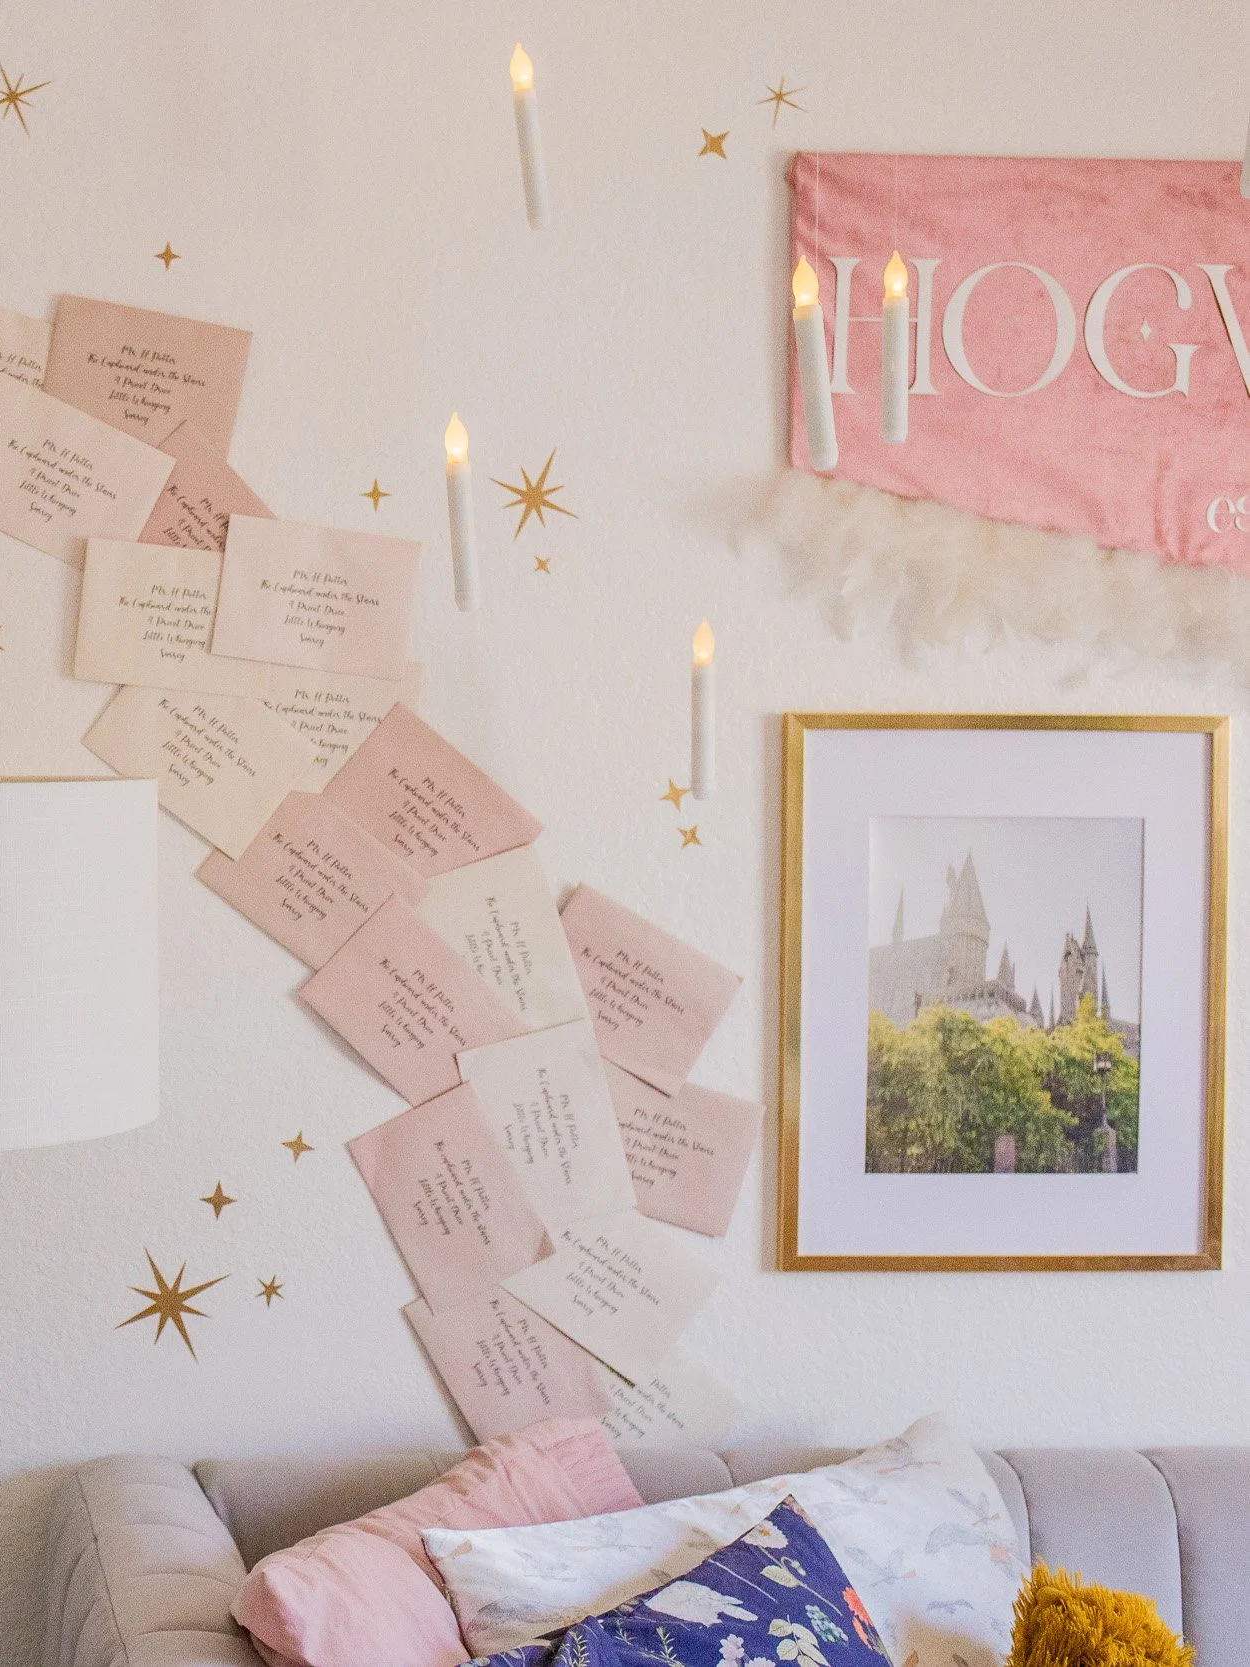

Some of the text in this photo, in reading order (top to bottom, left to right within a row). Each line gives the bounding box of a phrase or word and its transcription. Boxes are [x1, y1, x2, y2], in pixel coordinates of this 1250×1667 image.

[152, 351, 176, 365] Potter
[70, 453, 93, 471] Potter
[324, 574, 348, 586] Potter
[217, 724, 238, 744] Potter
[444, 797, 465, 818] Potter
[330, 859, 352, 880] Potter
[641, 966, 664, 984] Potter
[434, 991, 454, 1012] Potter
